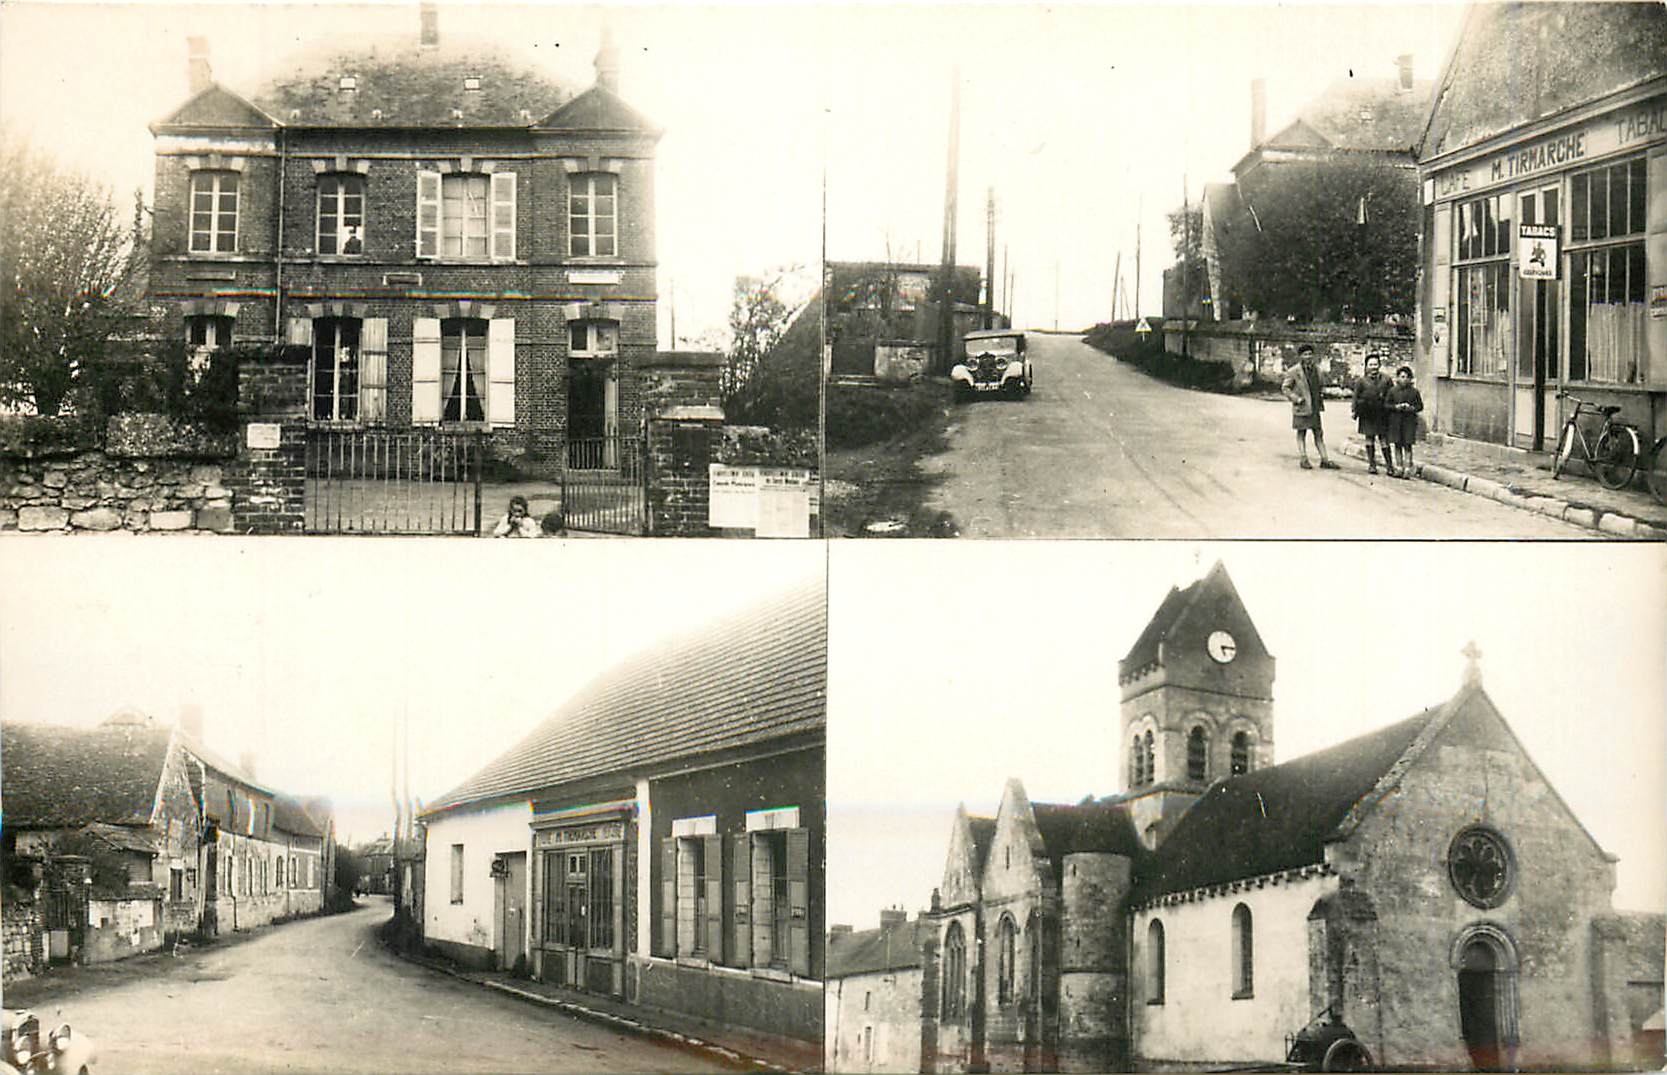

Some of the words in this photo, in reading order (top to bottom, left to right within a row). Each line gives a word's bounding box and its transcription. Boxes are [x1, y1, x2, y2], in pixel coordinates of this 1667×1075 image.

[1491, 160, 1504, 182] M.
[1508, 133, 1585, 177] TIRMARCHE
[1521, 225, 1555, 237] TABACS
